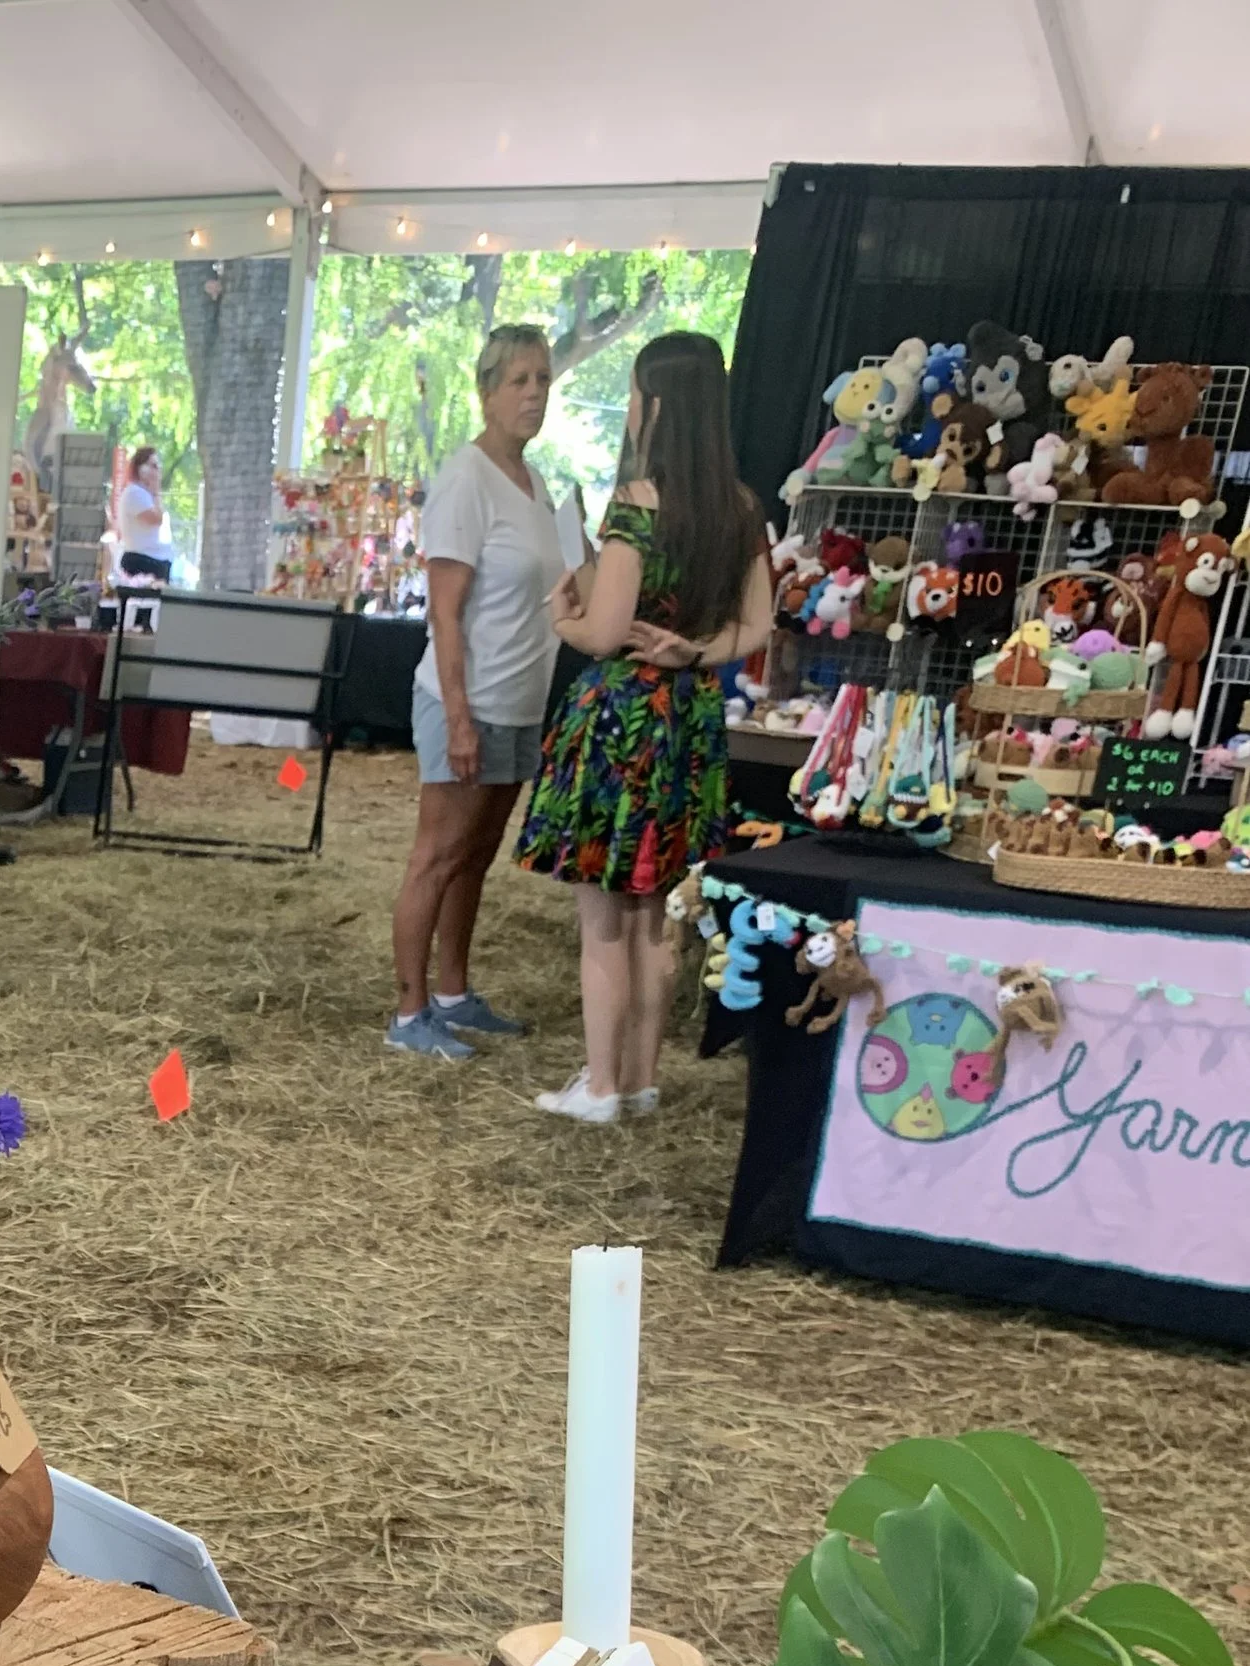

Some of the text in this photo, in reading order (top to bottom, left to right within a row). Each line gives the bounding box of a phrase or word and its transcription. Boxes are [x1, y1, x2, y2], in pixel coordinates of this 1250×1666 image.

[962, 571, 1003, 597] $10
[1111, 743, 1180, 764] $6 EACH
